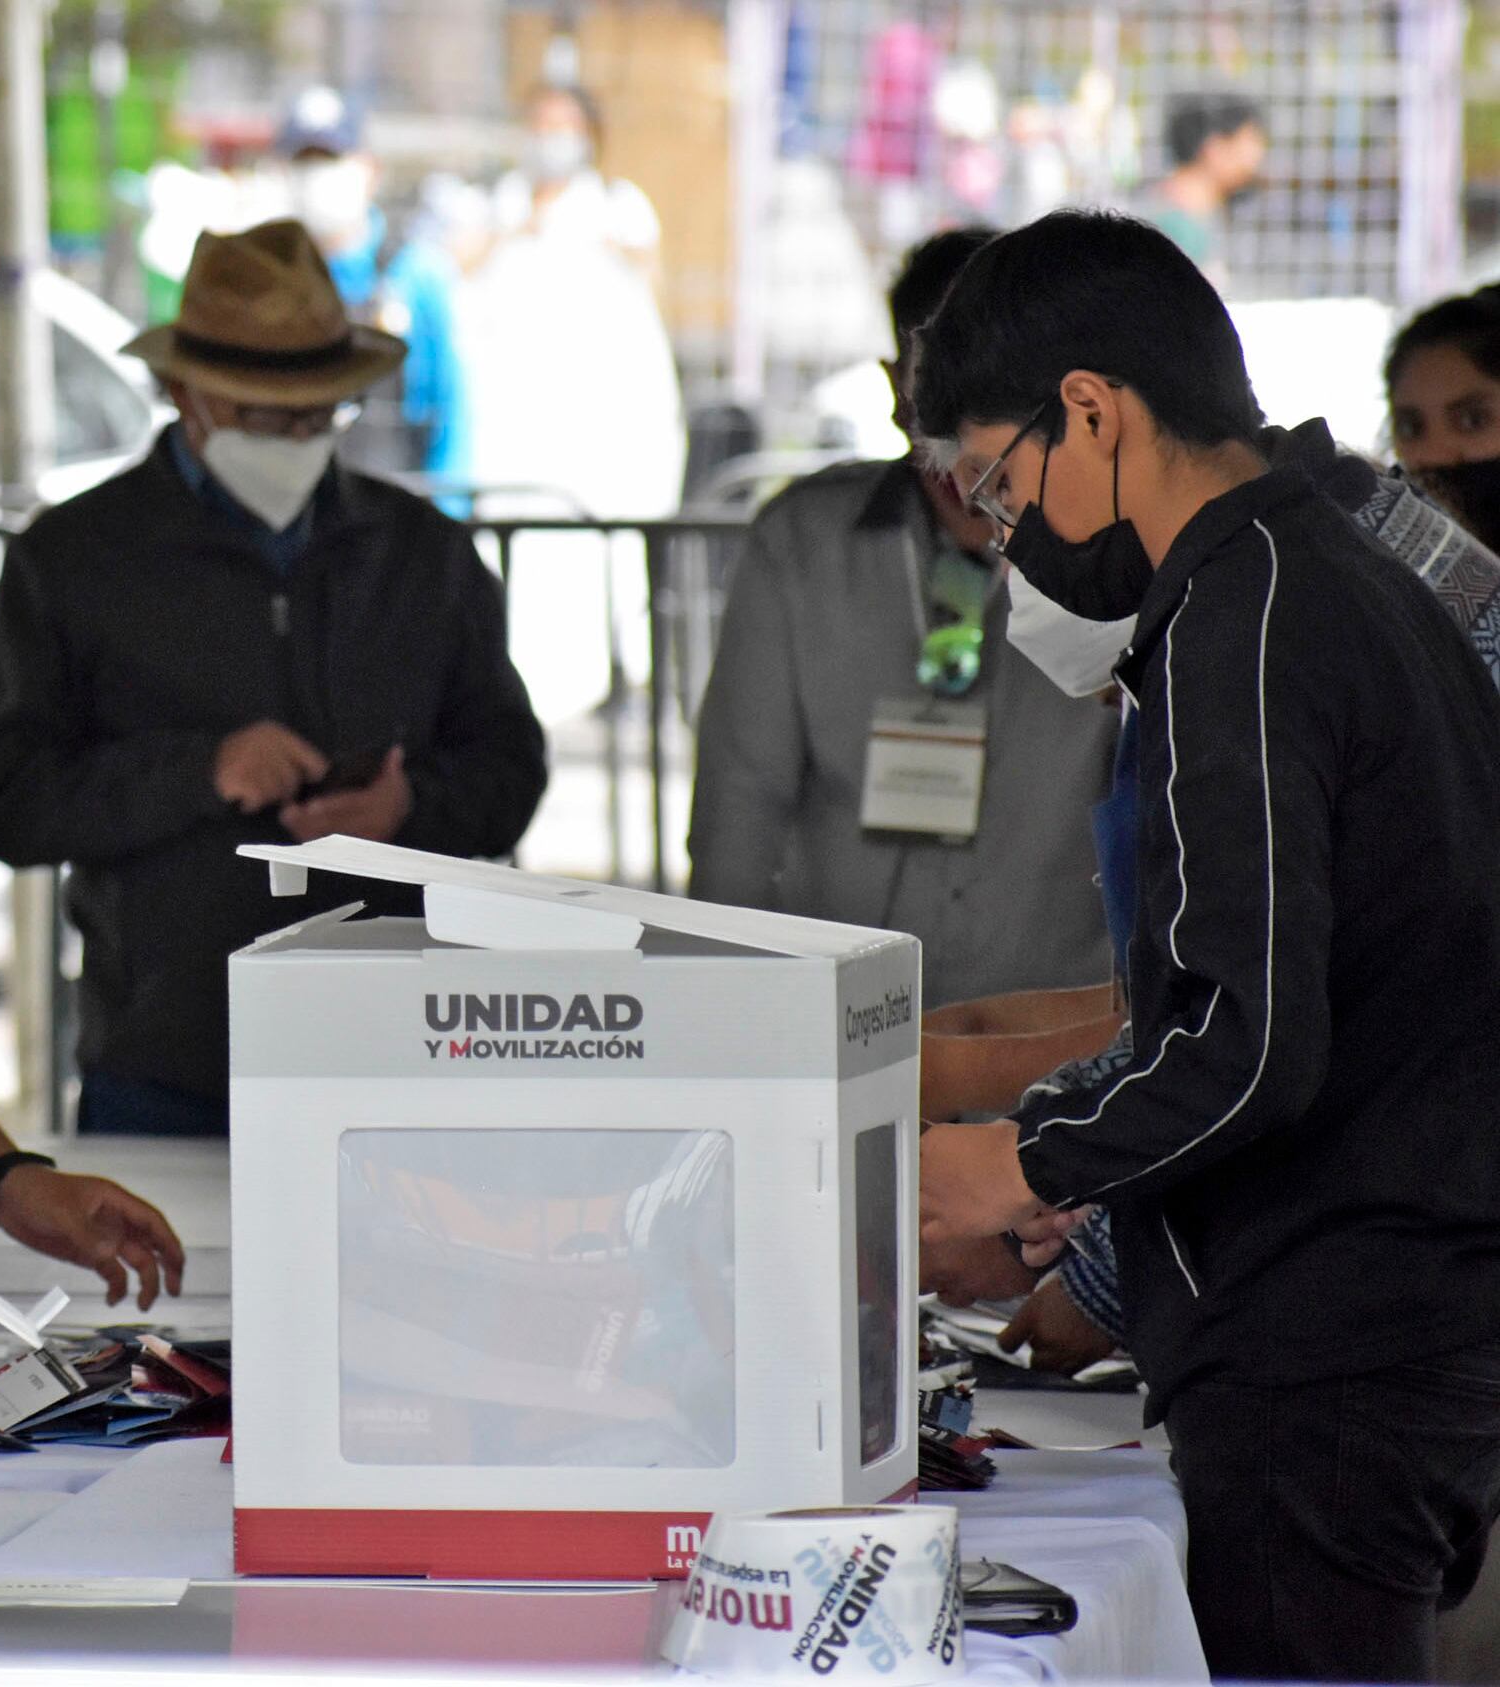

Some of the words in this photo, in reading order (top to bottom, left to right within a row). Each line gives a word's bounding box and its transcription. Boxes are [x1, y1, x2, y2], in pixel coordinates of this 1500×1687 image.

[425, 993, 644, 1033] UNIDAD
[845, 1004, 884, 1047] Congreso
[424, 1039, 443, 1059] Y
[449, 1035, 645, 1059] MOVILIZACIÓN
[667, 1555, 683, 1568] La
[810, 1543, 897, 1675] UNIDAD
